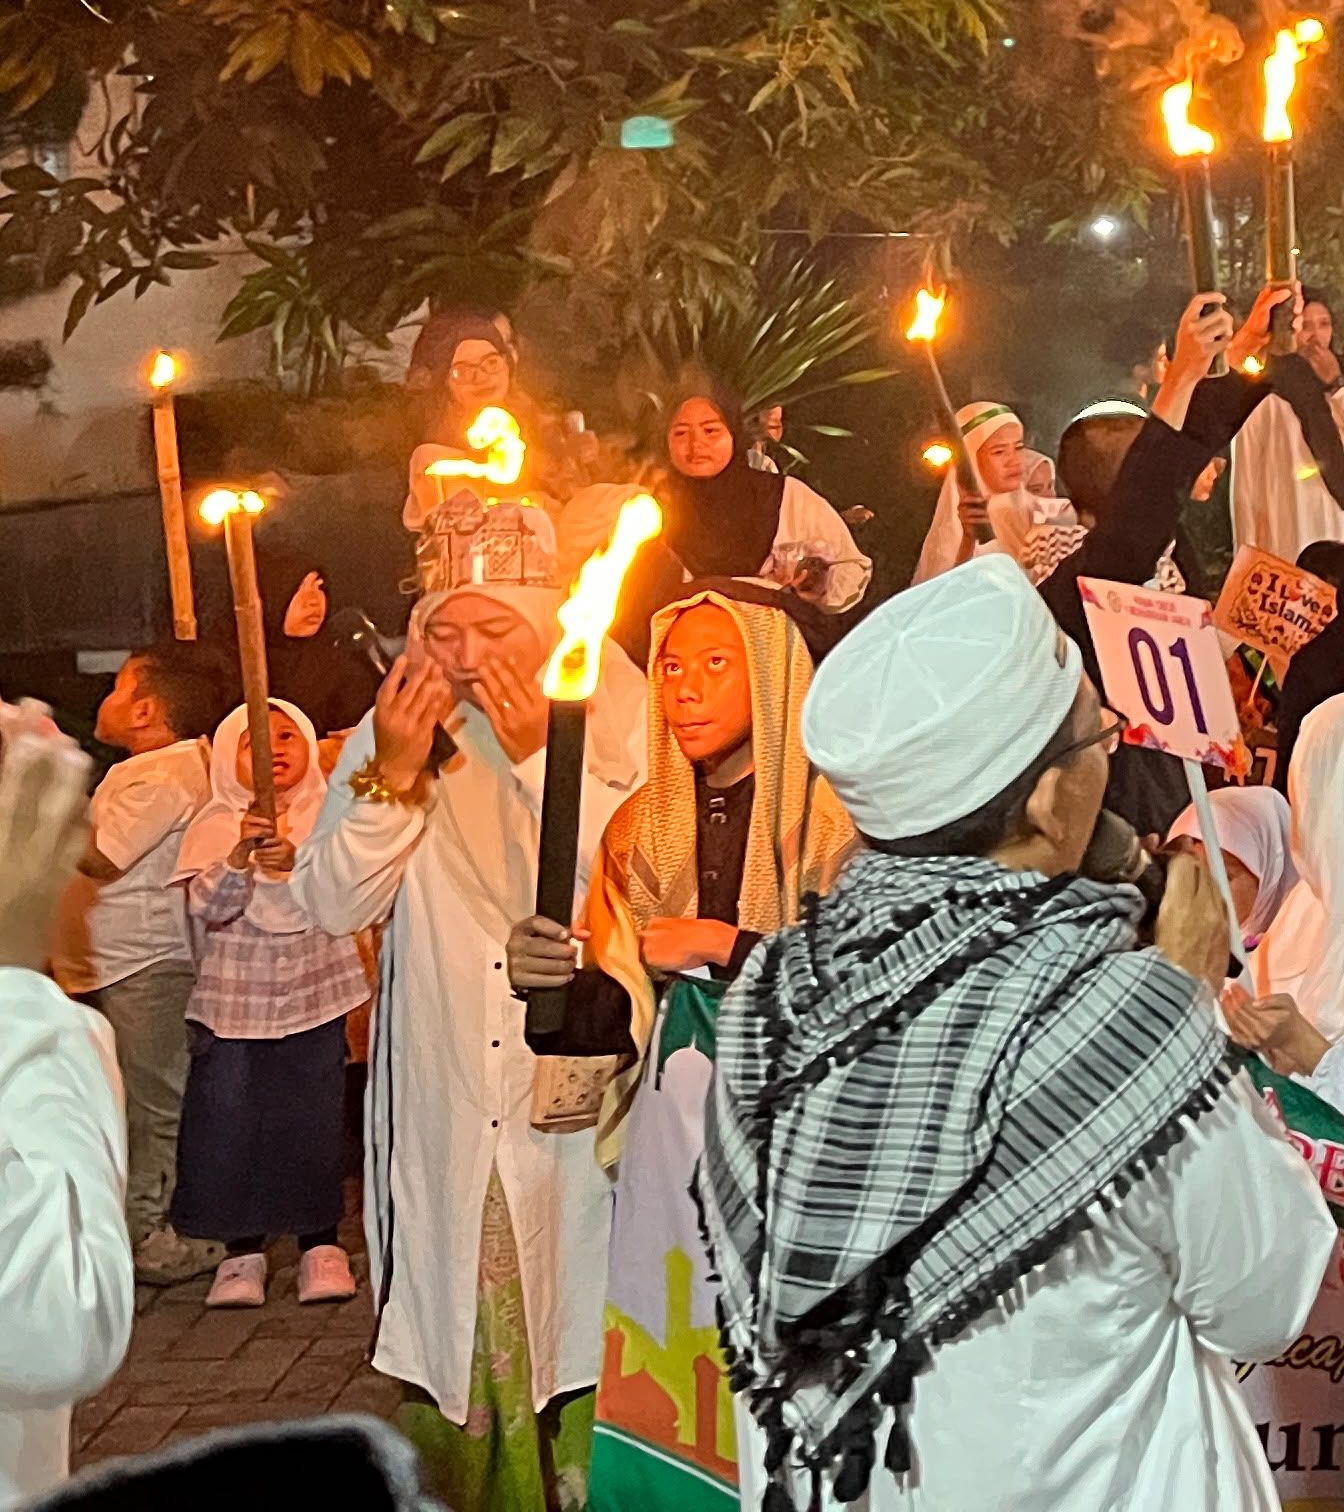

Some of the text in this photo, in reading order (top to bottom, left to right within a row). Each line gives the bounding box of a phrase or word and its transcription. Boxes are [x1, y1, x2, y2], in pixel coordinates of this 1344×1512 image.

[1266, 573, 1280, 593] I
[1258, 592, 1312, 633] Islam
[1128, 626, 1209, 735] 01
